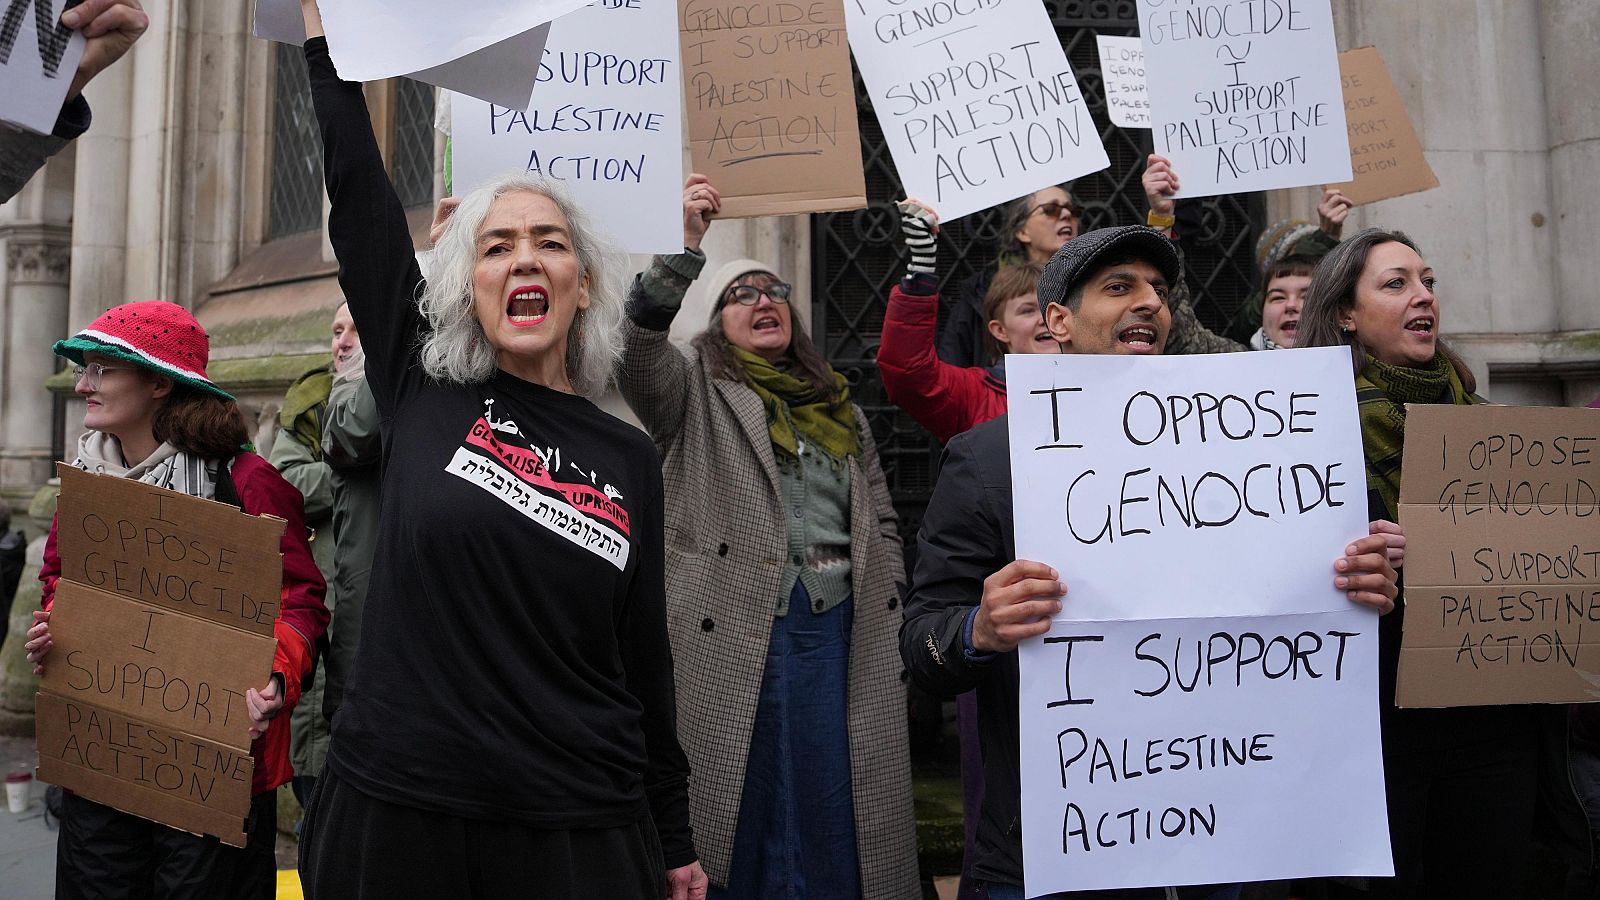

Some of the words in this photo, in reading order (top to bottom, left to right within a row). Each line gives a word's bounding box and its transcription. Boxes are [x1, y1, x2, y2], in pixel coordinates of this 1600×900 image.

[684, 0, 828, 37] GENOCIDE
[1148, 0, 1311, 45] GENOCIDE
[688, 40, 717, 67] I
[733, 28, 846, 58] SUPPORT
[942, 41, 954, 61] I
[1103, 45, 1118, 61] I
[691, 72, 838, 111] PALESTINE
[886, 41, 1041, 116] SUPPORT
[1106, 81, 1117, 93] I
[1121, 83, 1149, 93] SUP
[1194, 76, 1301, 116] SUPPORT
[1224, 61, 1248, 87] I
[489, 103, 665, 135] PALESTINE
[707, 106, 838, 159] ACTION
[904, 71, 1080, 154] PALESTINE
[1164, 103, 1328, 153] PALESTINE
[525, 150, 646, 183] ACTION
[936, 105, 1081, 203] ACTION
[1216, 135, 1306, 184] ACTION
[1030, 387, 1083, 450] I
[1123, 390, 1320, 446] OPPOSE
[1442, 434, 1447, 471] I
[1468, 434, 1597, 470] OPPOSE
[461, 459, 531, 508] גלובלית
[1066, 462, 1346, 544] GENOCIDE
[148, 493, 175, 526] I
[533, 501, 622, 557] התקוממות
[82, 513, 237, 574] OPPOSE
[1450, 550, 1457, 579] I
[1473, 544, 1600, 583] SUPPORT
[84, 552, 275, 626] GENOCIDE
[1440, 590, 1600, 628] PALESTINE
[131, 610, 164, 654] I
[1456, 624, 1582, 670] ACTION
[66, 650, 247, 727] SUPPORT
[1043, 635, 1104, 708] I
[1134, 630, 1361, 697] SUPPORT
[66, 703, 250, 781] PALESTINE
[1057, 727, 1276, 789] PALESTINE
[61, 735, 216, 802] ACTION
[1062, 803, 1216, 854] ACTION
